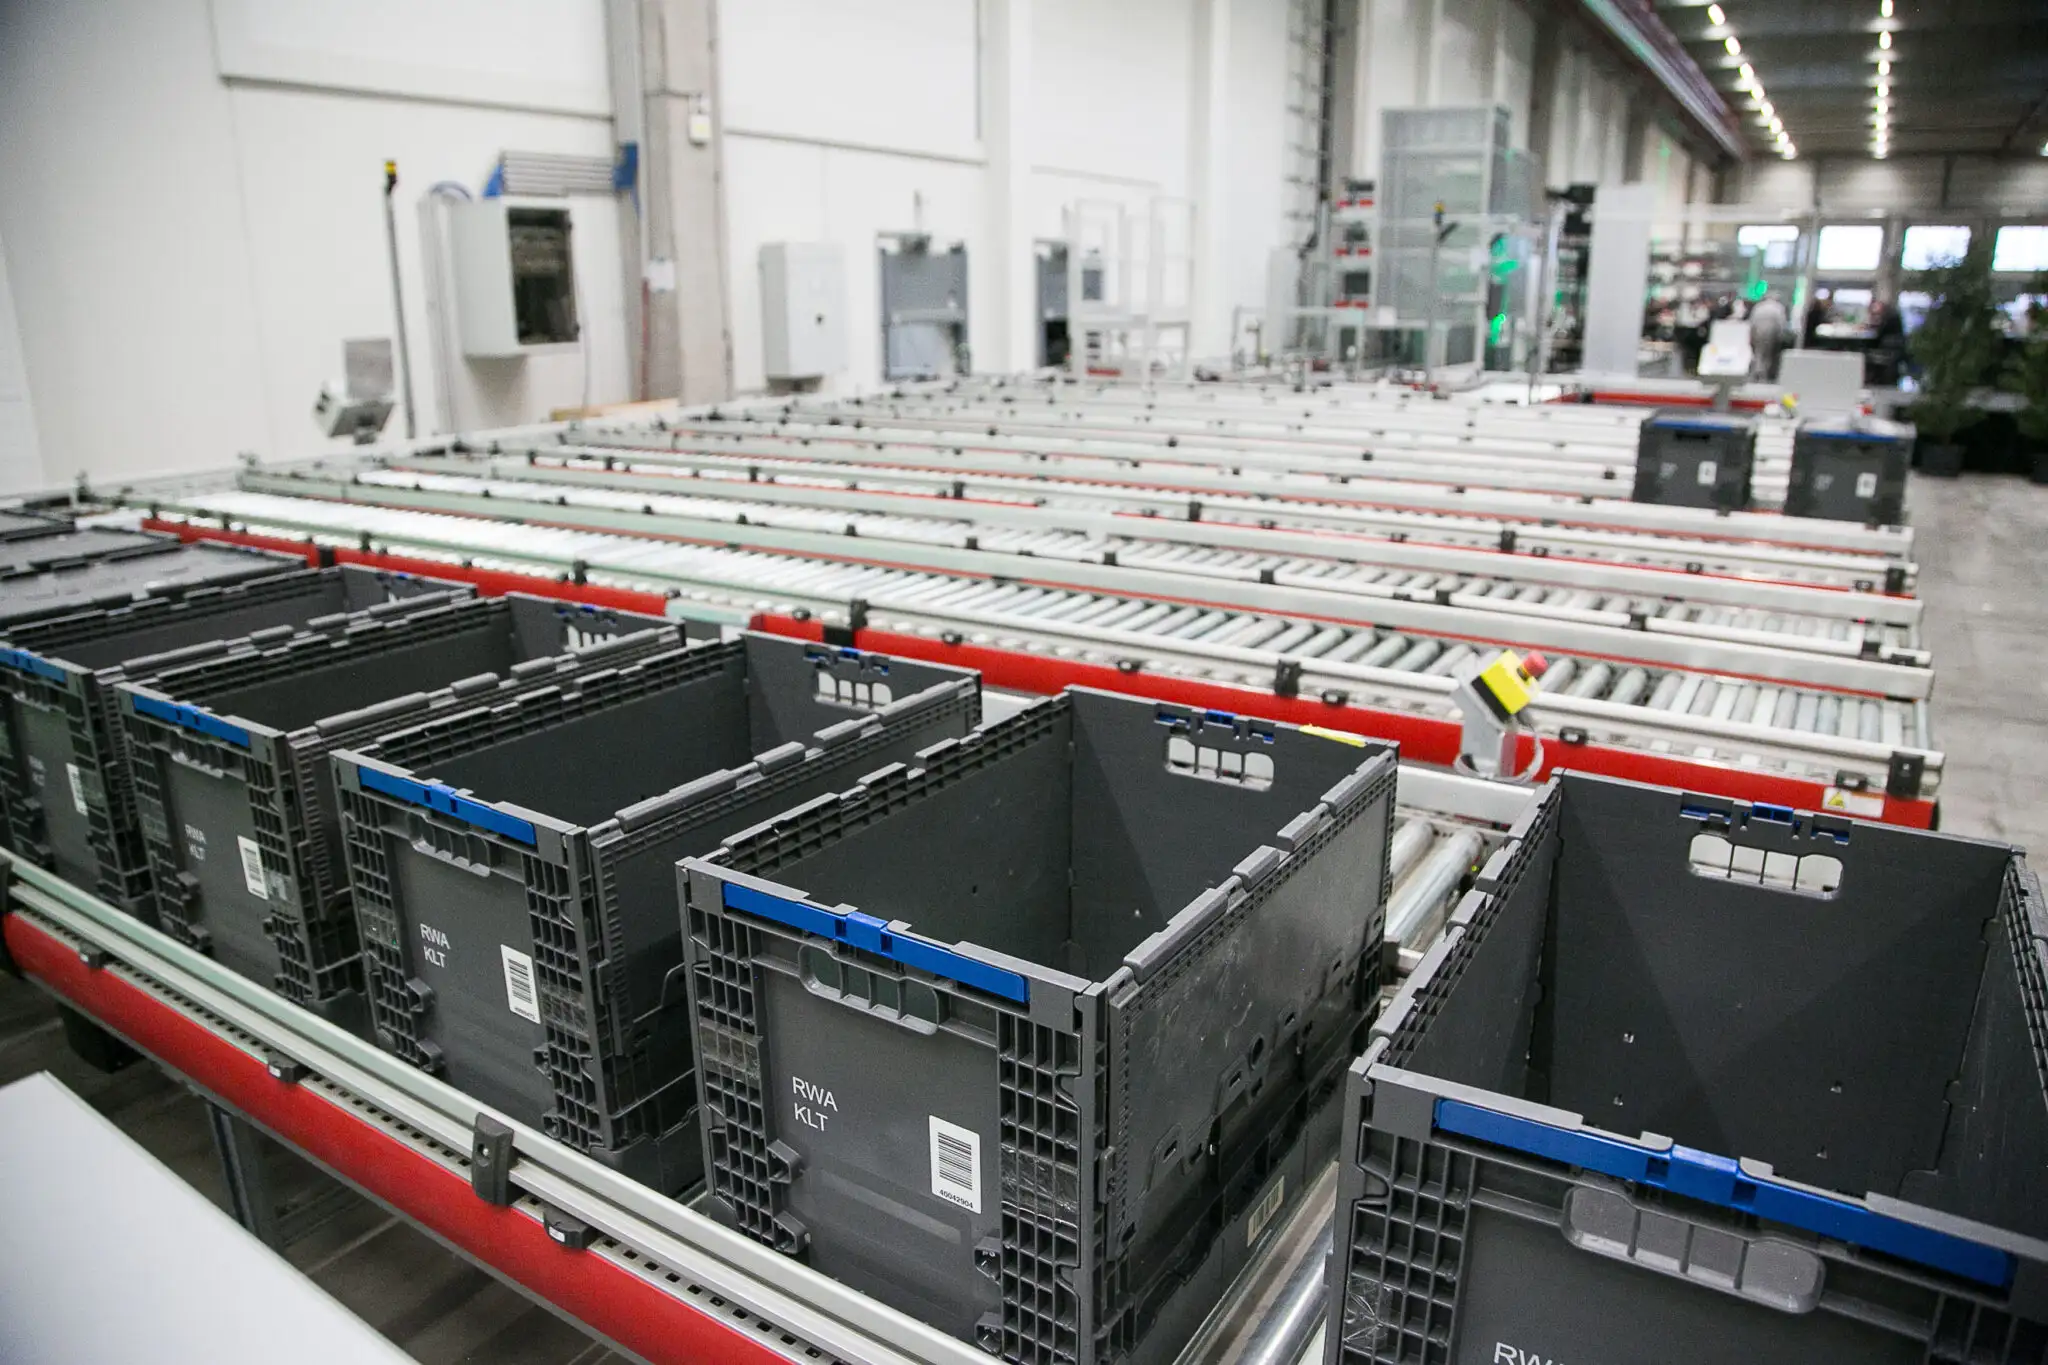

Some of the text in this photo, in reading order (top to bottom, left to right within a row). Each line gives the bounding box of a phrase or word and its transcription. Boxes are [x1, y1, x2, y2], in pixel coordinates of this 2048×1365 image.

[420, 923, 451, 950] RWA
[423, 945, 446, 968] KLT
[792, 1076, 838, 1112] RWA
[794, 1102, 828, 1132] KLT
[1494, 1342, 1564, 1365] RW
